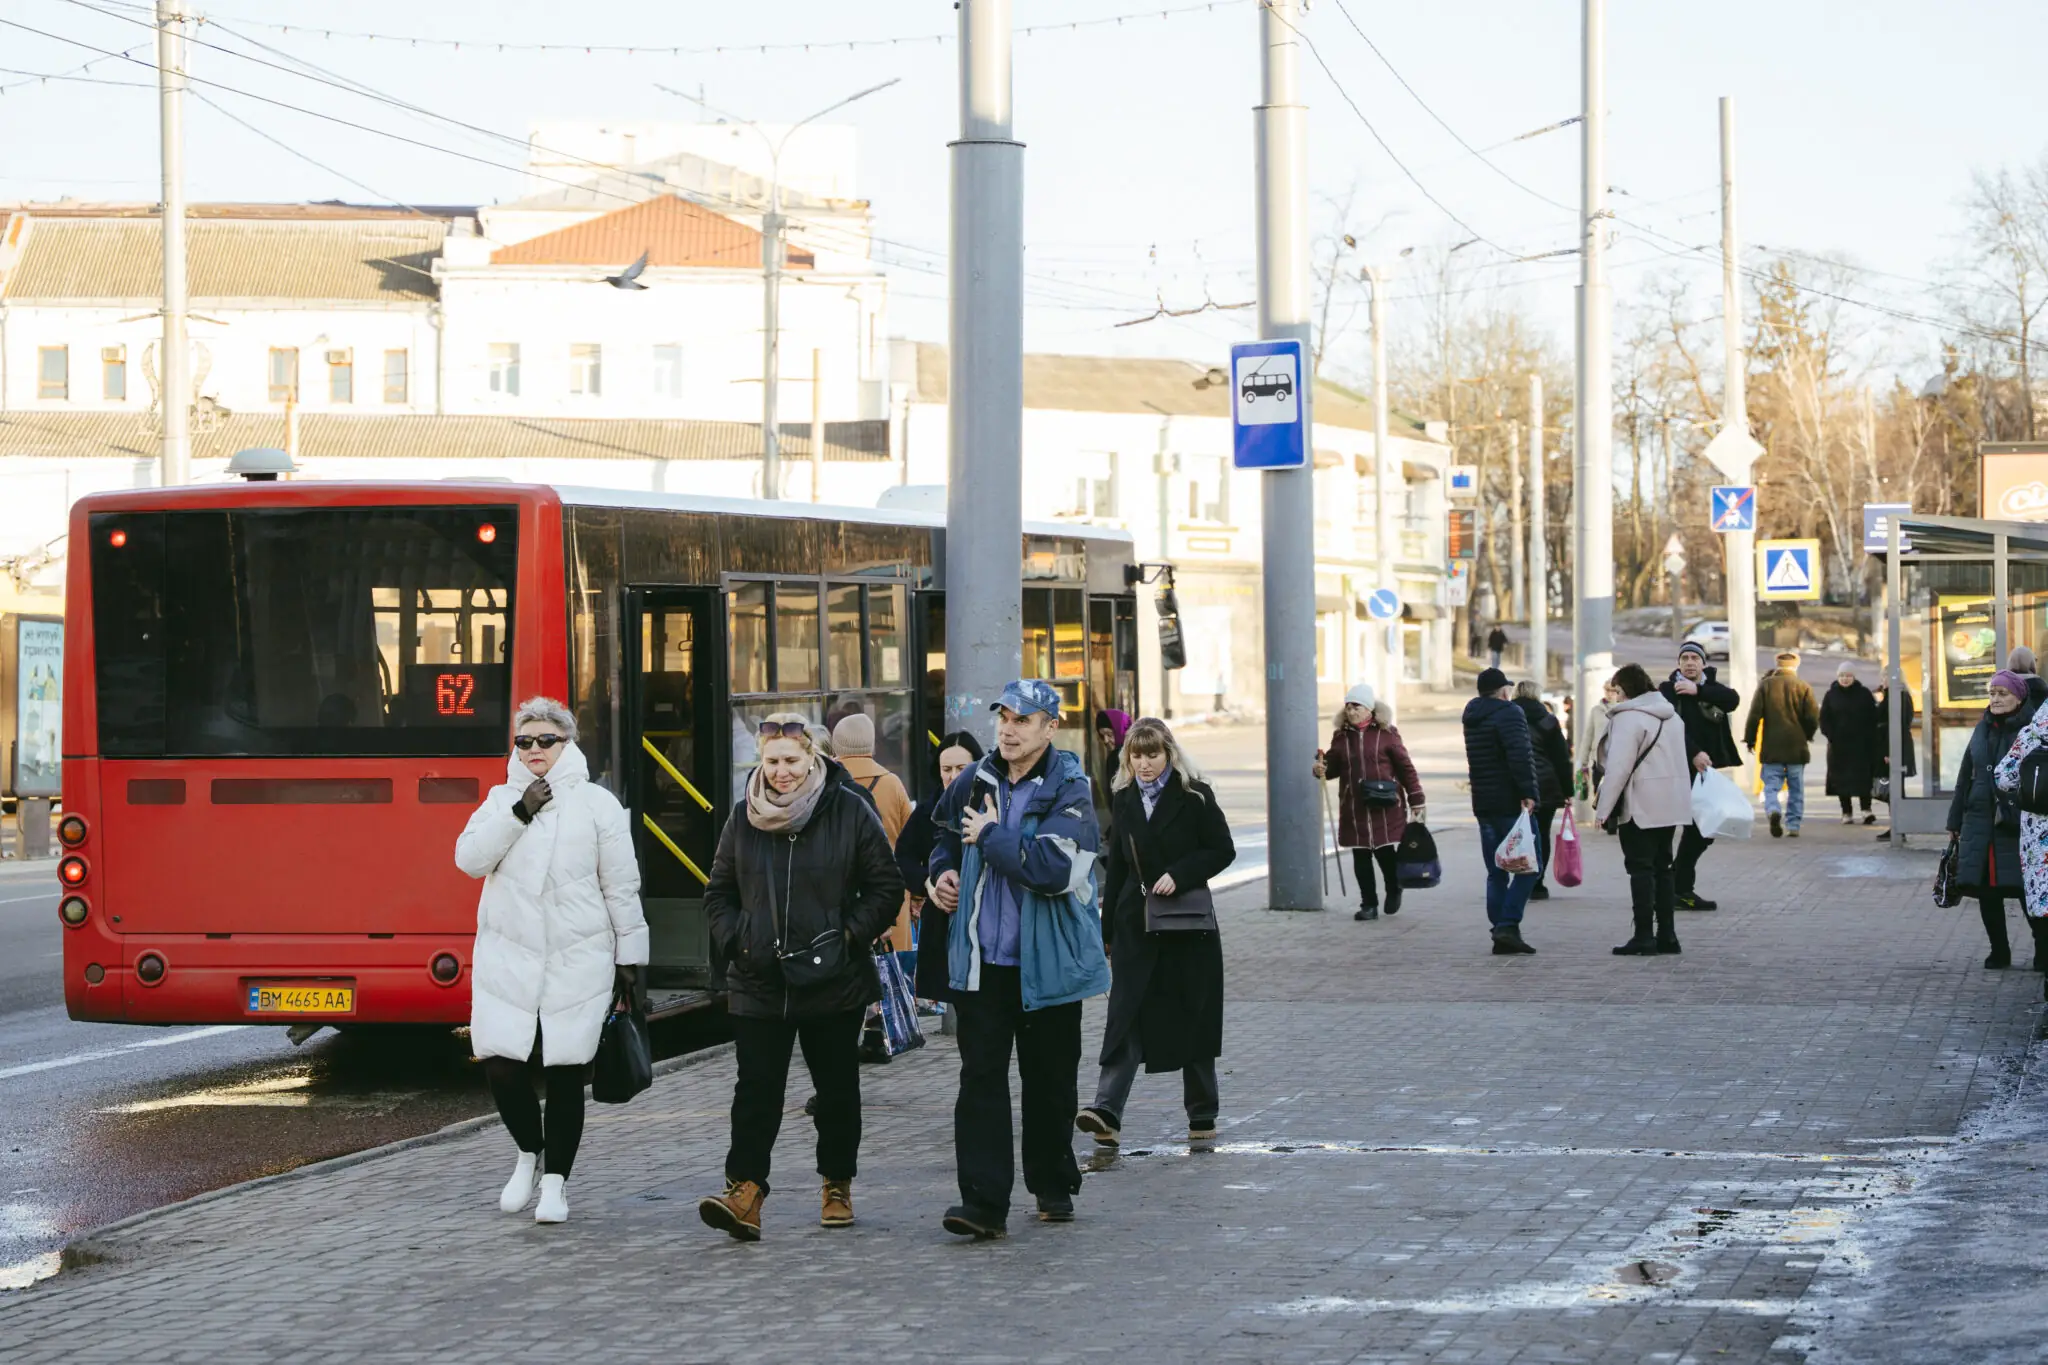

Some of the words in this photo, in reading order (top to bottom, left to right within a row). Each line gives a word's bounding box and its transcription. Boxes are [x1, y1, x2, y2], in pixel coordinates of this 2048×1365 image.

[437, 674, 474, 714] 62
[260, 991, 282, 1007] BM
[286, 991, 320, 1008] 4665
[324, 992, 345, 1008] AA
